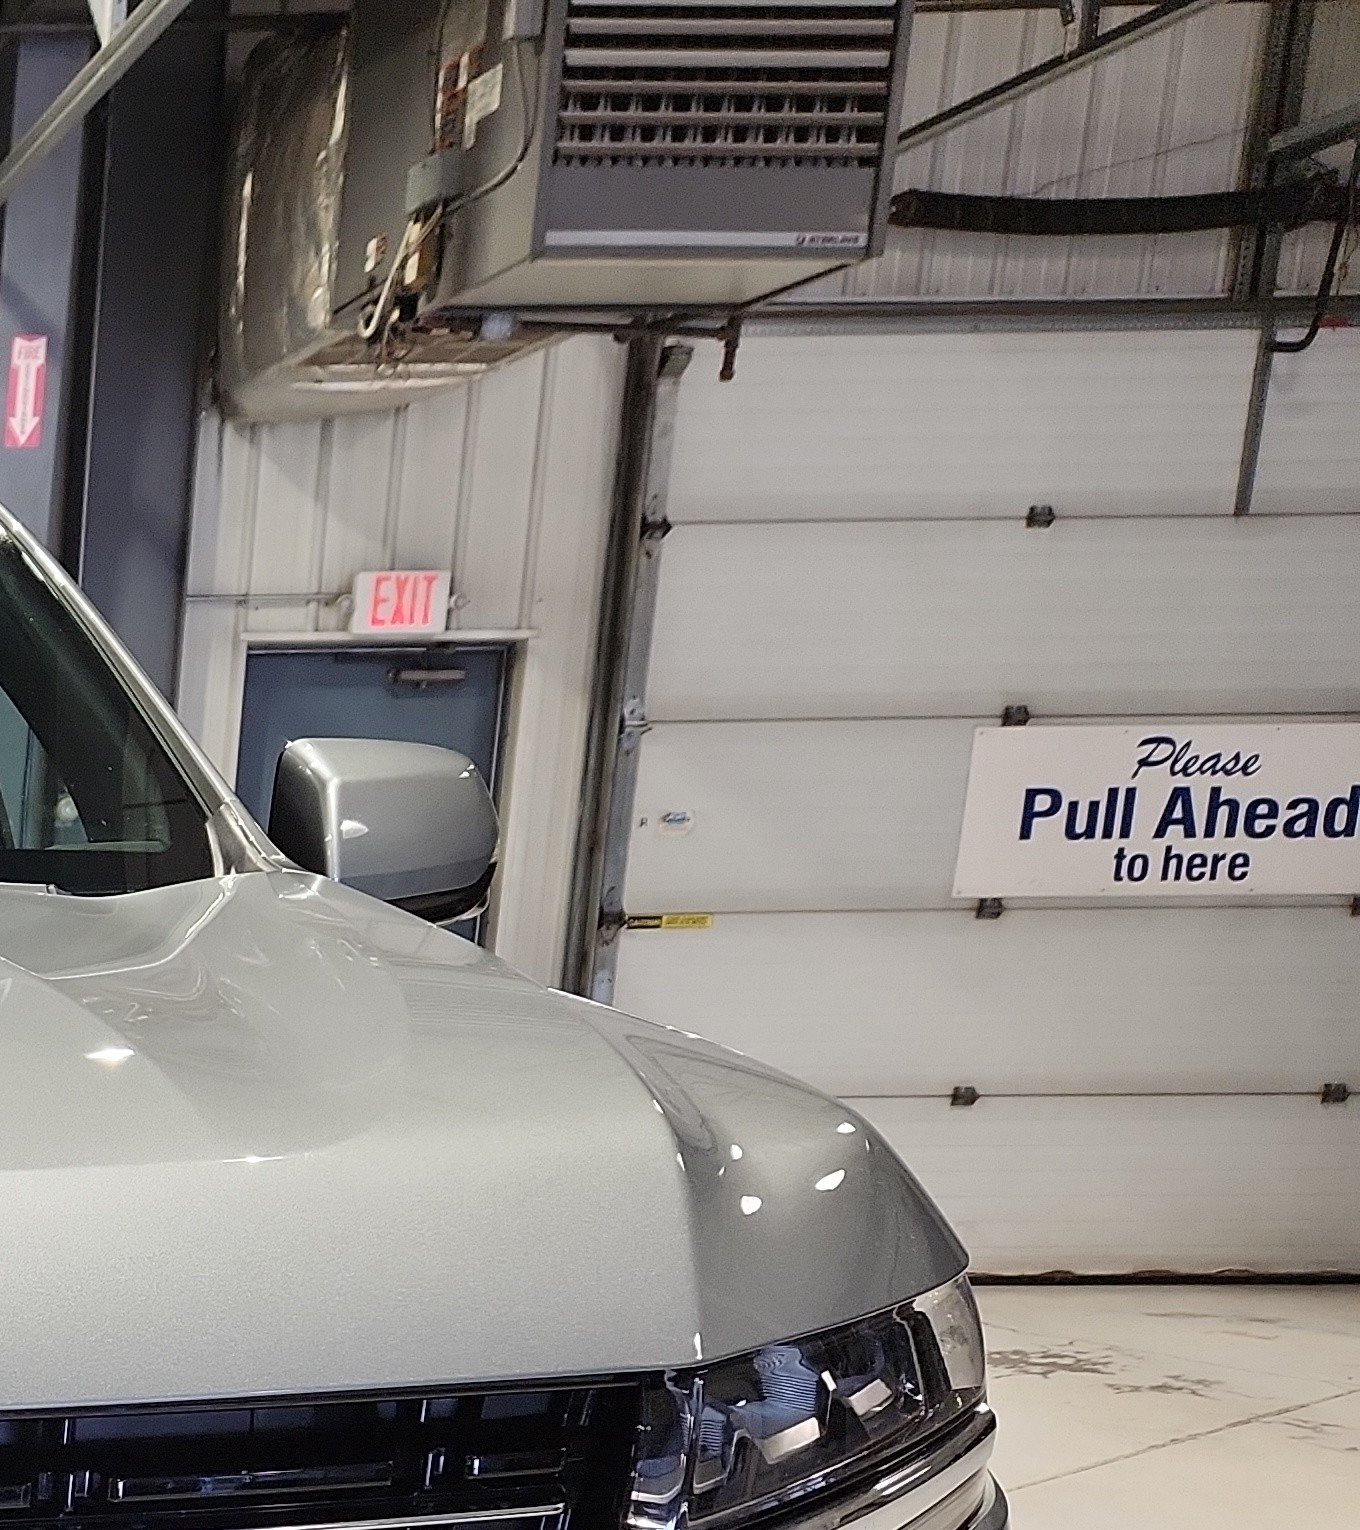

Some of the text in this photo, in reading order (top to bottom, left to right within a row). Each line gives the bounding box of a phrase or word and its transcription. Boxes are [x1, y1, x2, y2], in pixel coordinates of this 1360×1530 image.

[370, 574, 438, 627] EXIT
[1130, 735, 1263, 780] Please
[1018, 784, 1360, 841] Pull Ahead
[1112, 845, 1252, 883] to here
